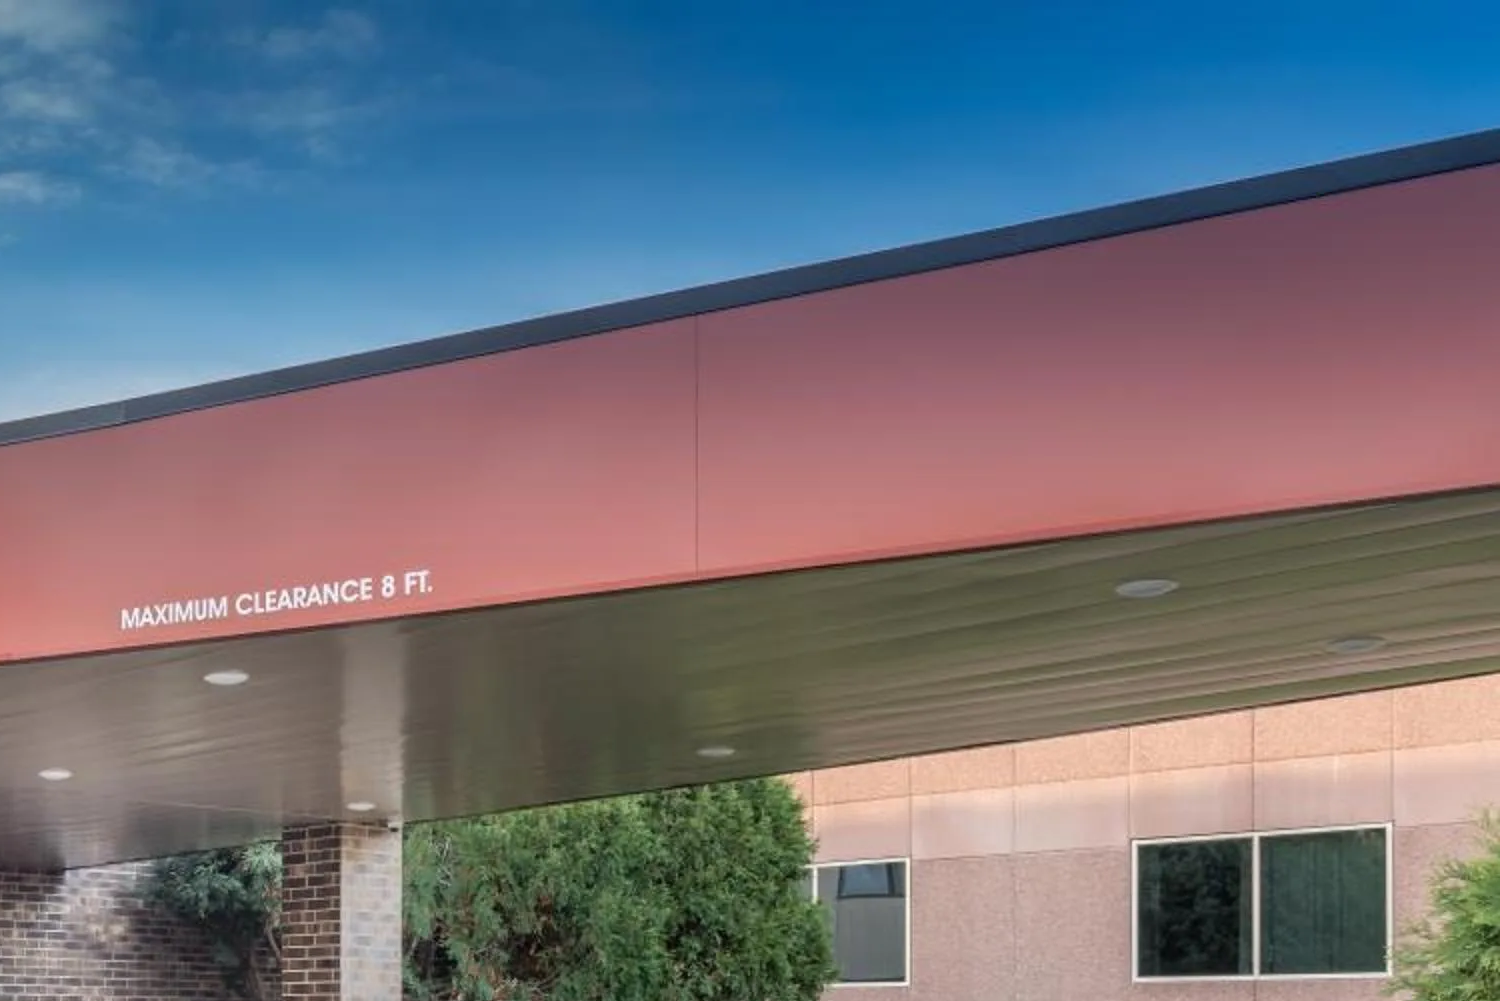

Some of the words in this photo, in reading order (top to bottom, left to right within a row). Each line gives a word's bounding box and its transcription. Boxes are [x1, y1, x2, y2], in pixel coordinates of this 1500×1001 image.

[120, 596, 228, 630] MAXIMUM
[235, 577, 374, 616] CLEARANCE
[381, 575, 396, 598] 8
[403, 569, 434, 596] FT.
